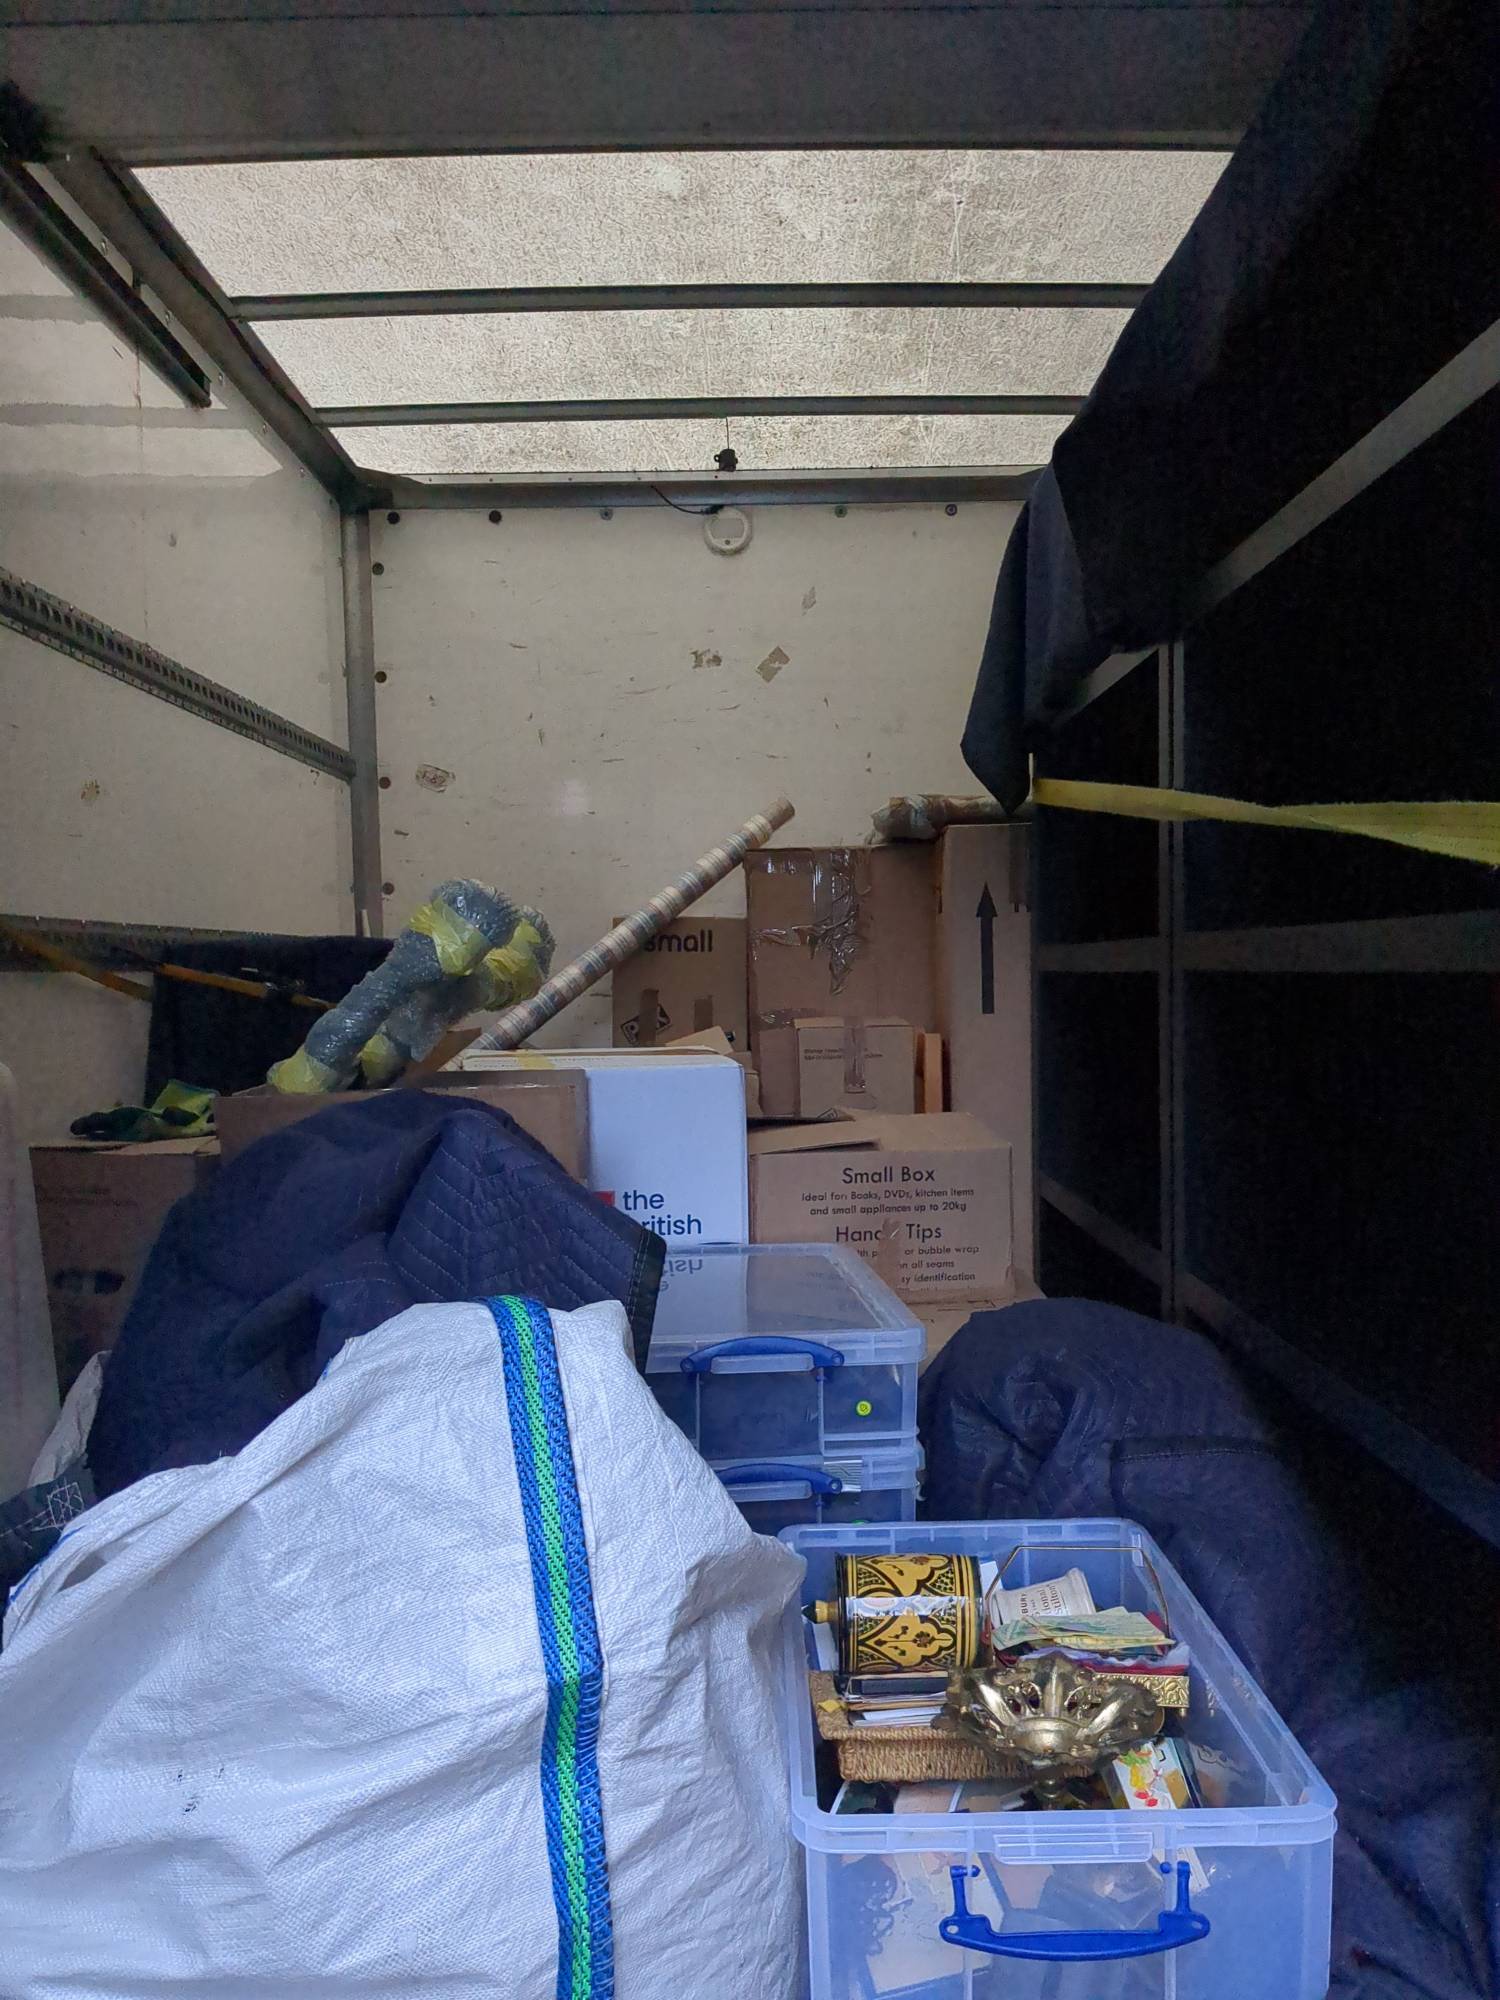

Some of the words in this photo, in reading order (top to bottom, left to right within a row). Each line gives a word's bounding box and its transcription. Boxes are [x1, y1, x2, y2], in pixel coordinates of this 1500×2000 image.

[842, 1166, 893, 1184] Small
[901, 1166, 936, 1182] Box
[622, 1189, 665, 1211] the
[915, 1188, 948, 1198] kitchen
[951, 1187, 974, 1197] items
[810, 1206, 829, 1216] and
[832, 1204, 857, 1215] small
[860, 1202, 911, 1216] appliances
[914, 1204, 926, 1214] up
[929, 1202, 939, 1212] to
[942, 1201, 967, 1213] 20kg
[641, 1214, 702, 1236] ritish
[906, 1222, 942, 1243] Tips
[918, 1245, 951, 1255] bubble
[954, 1245, 980, 1256] wrap
[911, 1259, 923, 1269] all
[926, 1259, 954, 1269] seams
[914, 1271, 976, 1282] identification
